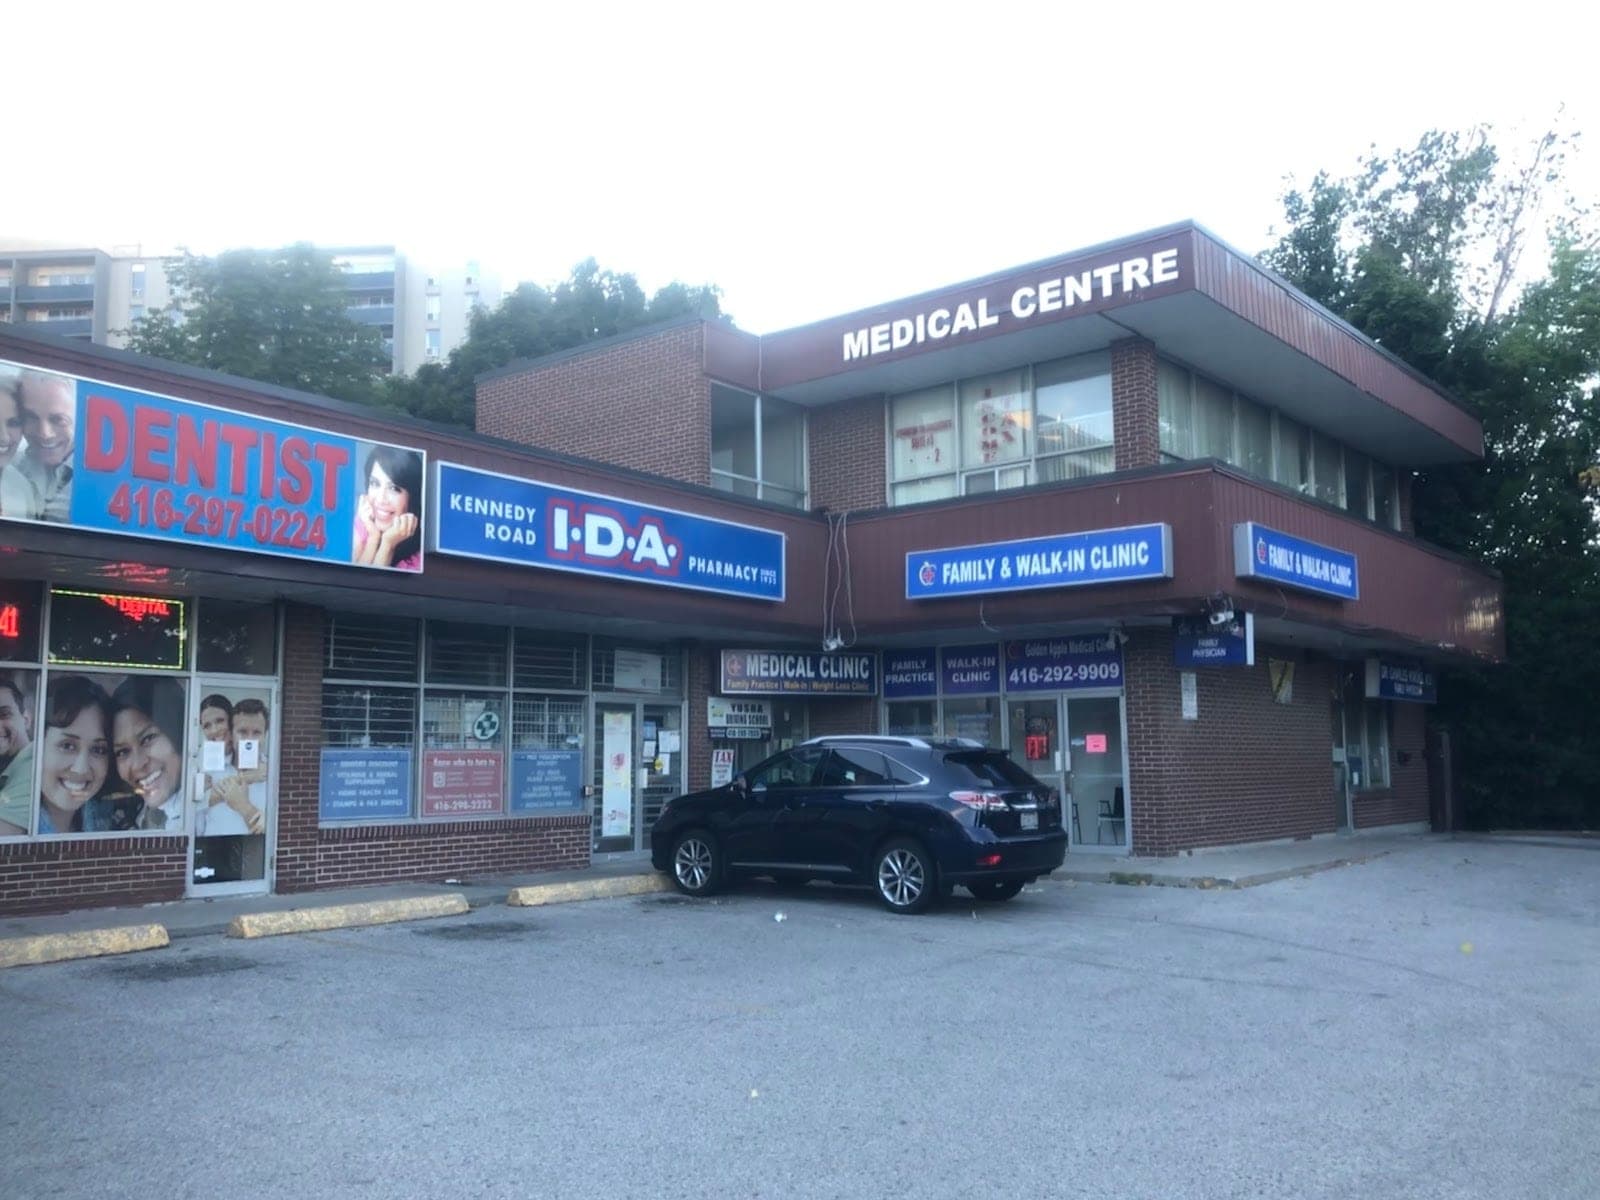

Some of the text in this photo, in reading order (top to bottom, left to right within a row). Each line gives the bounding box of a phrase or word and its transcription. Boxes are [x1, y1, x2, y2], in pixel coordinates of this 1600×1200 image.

[843, 247, 1179, 361] MEDICAL CENTRE
[84, 395, 349, 510] DENTIST
[108, 483, 326, 552] 416-297-0224
[450, 493, 537, 524] KENNEDY
[485, 522, 537, 546] ROAD
[688, 555, 758, 582] PHARMACY
[942, 540, 1149, 585] FAMILY & WALK-IN CLINIC
[1268, 543, 1352, 588] FAMILY & WALK-IN CLINIC
[746, 654, 869, 679] MEDICAL CLINIC
[891, 659, 927, 670] FAMILY
[946, 656, 996, 670] WALK-IN
[1009, 662, 1120, 684] 416-292-9909
[750, 680, 778, 690] Practice
[885, 671, 935, 684] PRACTICE
[952, 671, 991, 683] CLINIC
